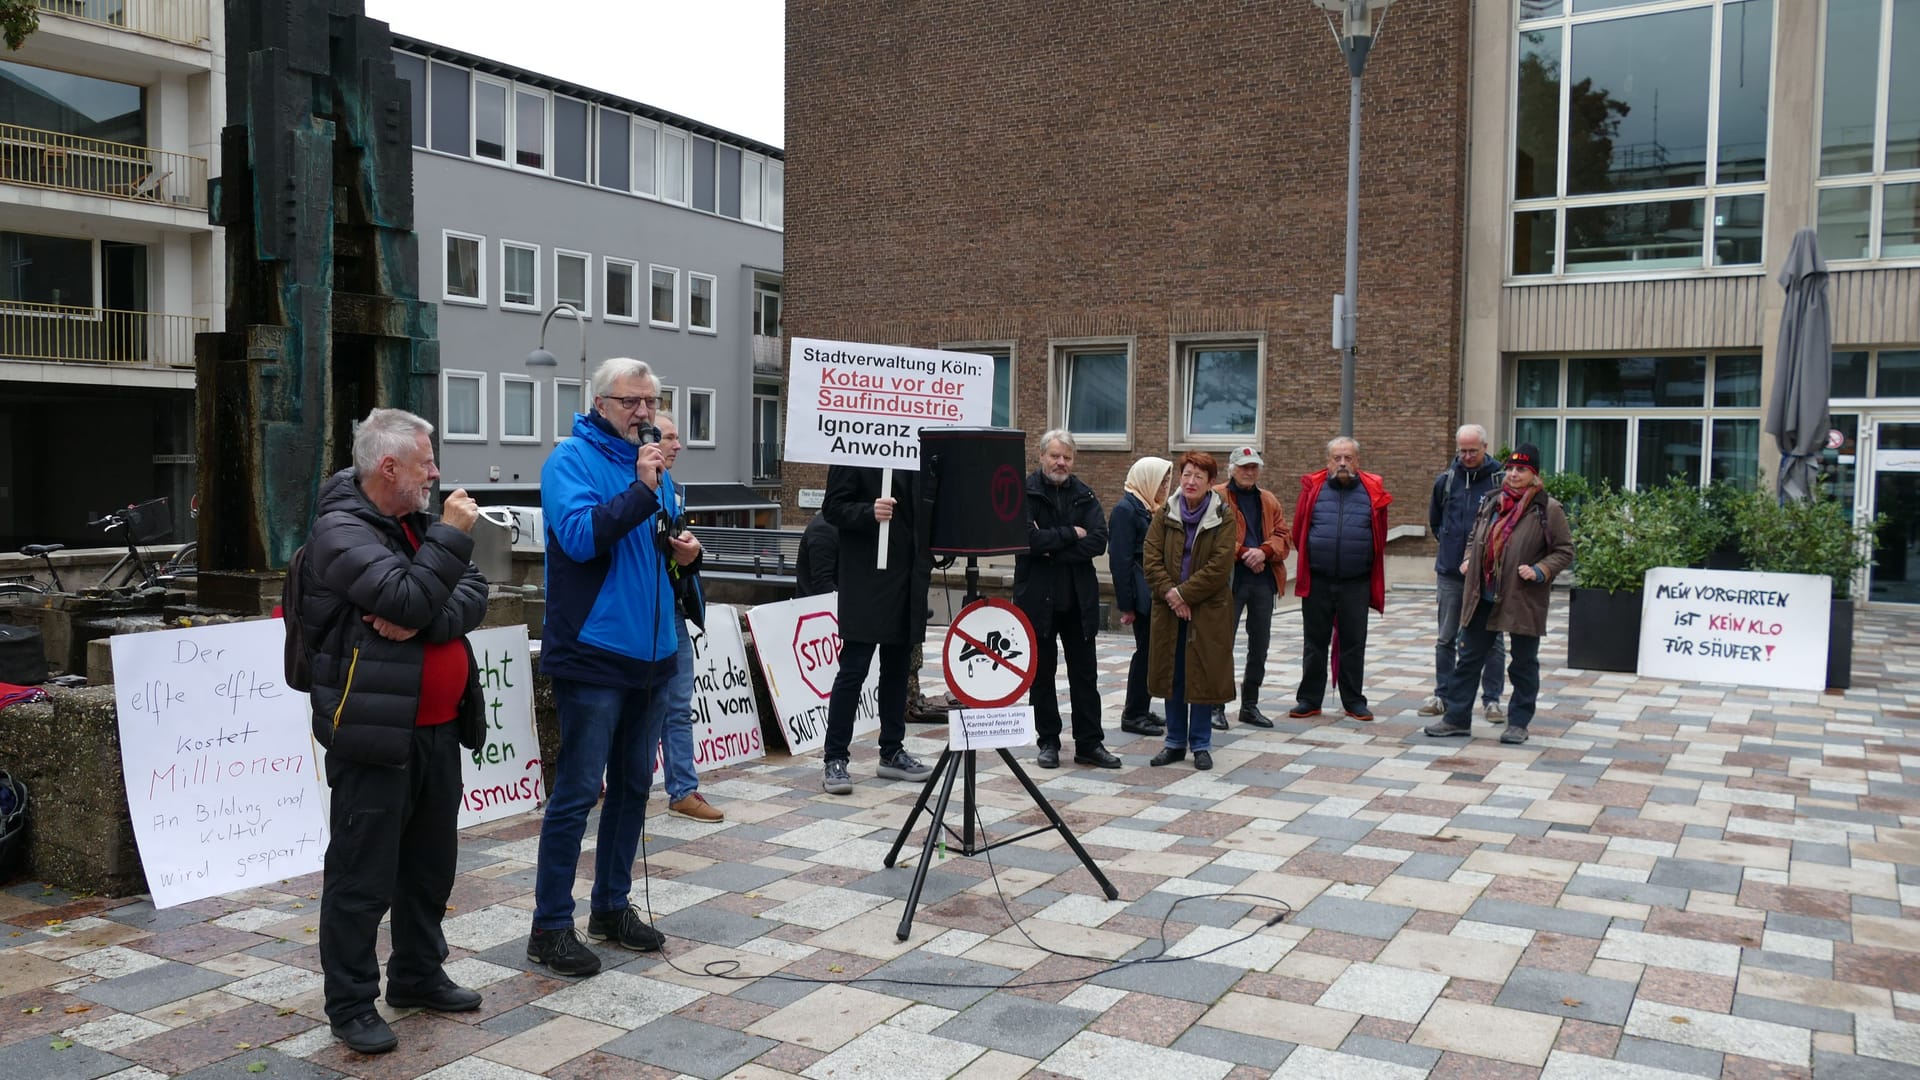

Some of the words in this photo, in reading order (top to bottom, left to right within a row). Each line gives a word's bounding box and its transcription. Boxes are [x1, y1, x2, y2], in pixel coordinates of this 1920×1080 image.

[803, 347, 936, 375] Stadtverwaltung
[941, 360, 982, 376] Köln:
[821, 368, 883, 388] Kotau
[890, 377, 925, 392] vor
[931, 377, 964, 396] der
[818, 389, 964, 420] Saufindustrie,
[818, 414, 910, 437] Ignoranz
[831, 436, 920, 459] Anwohn
[1694, 586, 1790, 608] VORGARTEN
[1748, 619, 1783, 636] KLO
[174, 640, 226, 664] Der
[801, 632, 843, 671] STOP
[1663, 636, 1693, 655] FÜR
[478, 649, 514, 690] cht
[722, 656, 748, 691] die
[131, 680, 186, 725] elfte
[215, 670, 283, 714] elfte
[690, 696, 711, 724] oll
[717, 697, 754, 717] vom
[967, 720, 995, 728] Karneval
[150, 753, 304, 800] Millionen
[460, 759, 545, 812] ismus?
[153, 815, 179, 832] An
[196, 796, 261, 825] Bildung
[200, 818, 272, 844] Kultur
